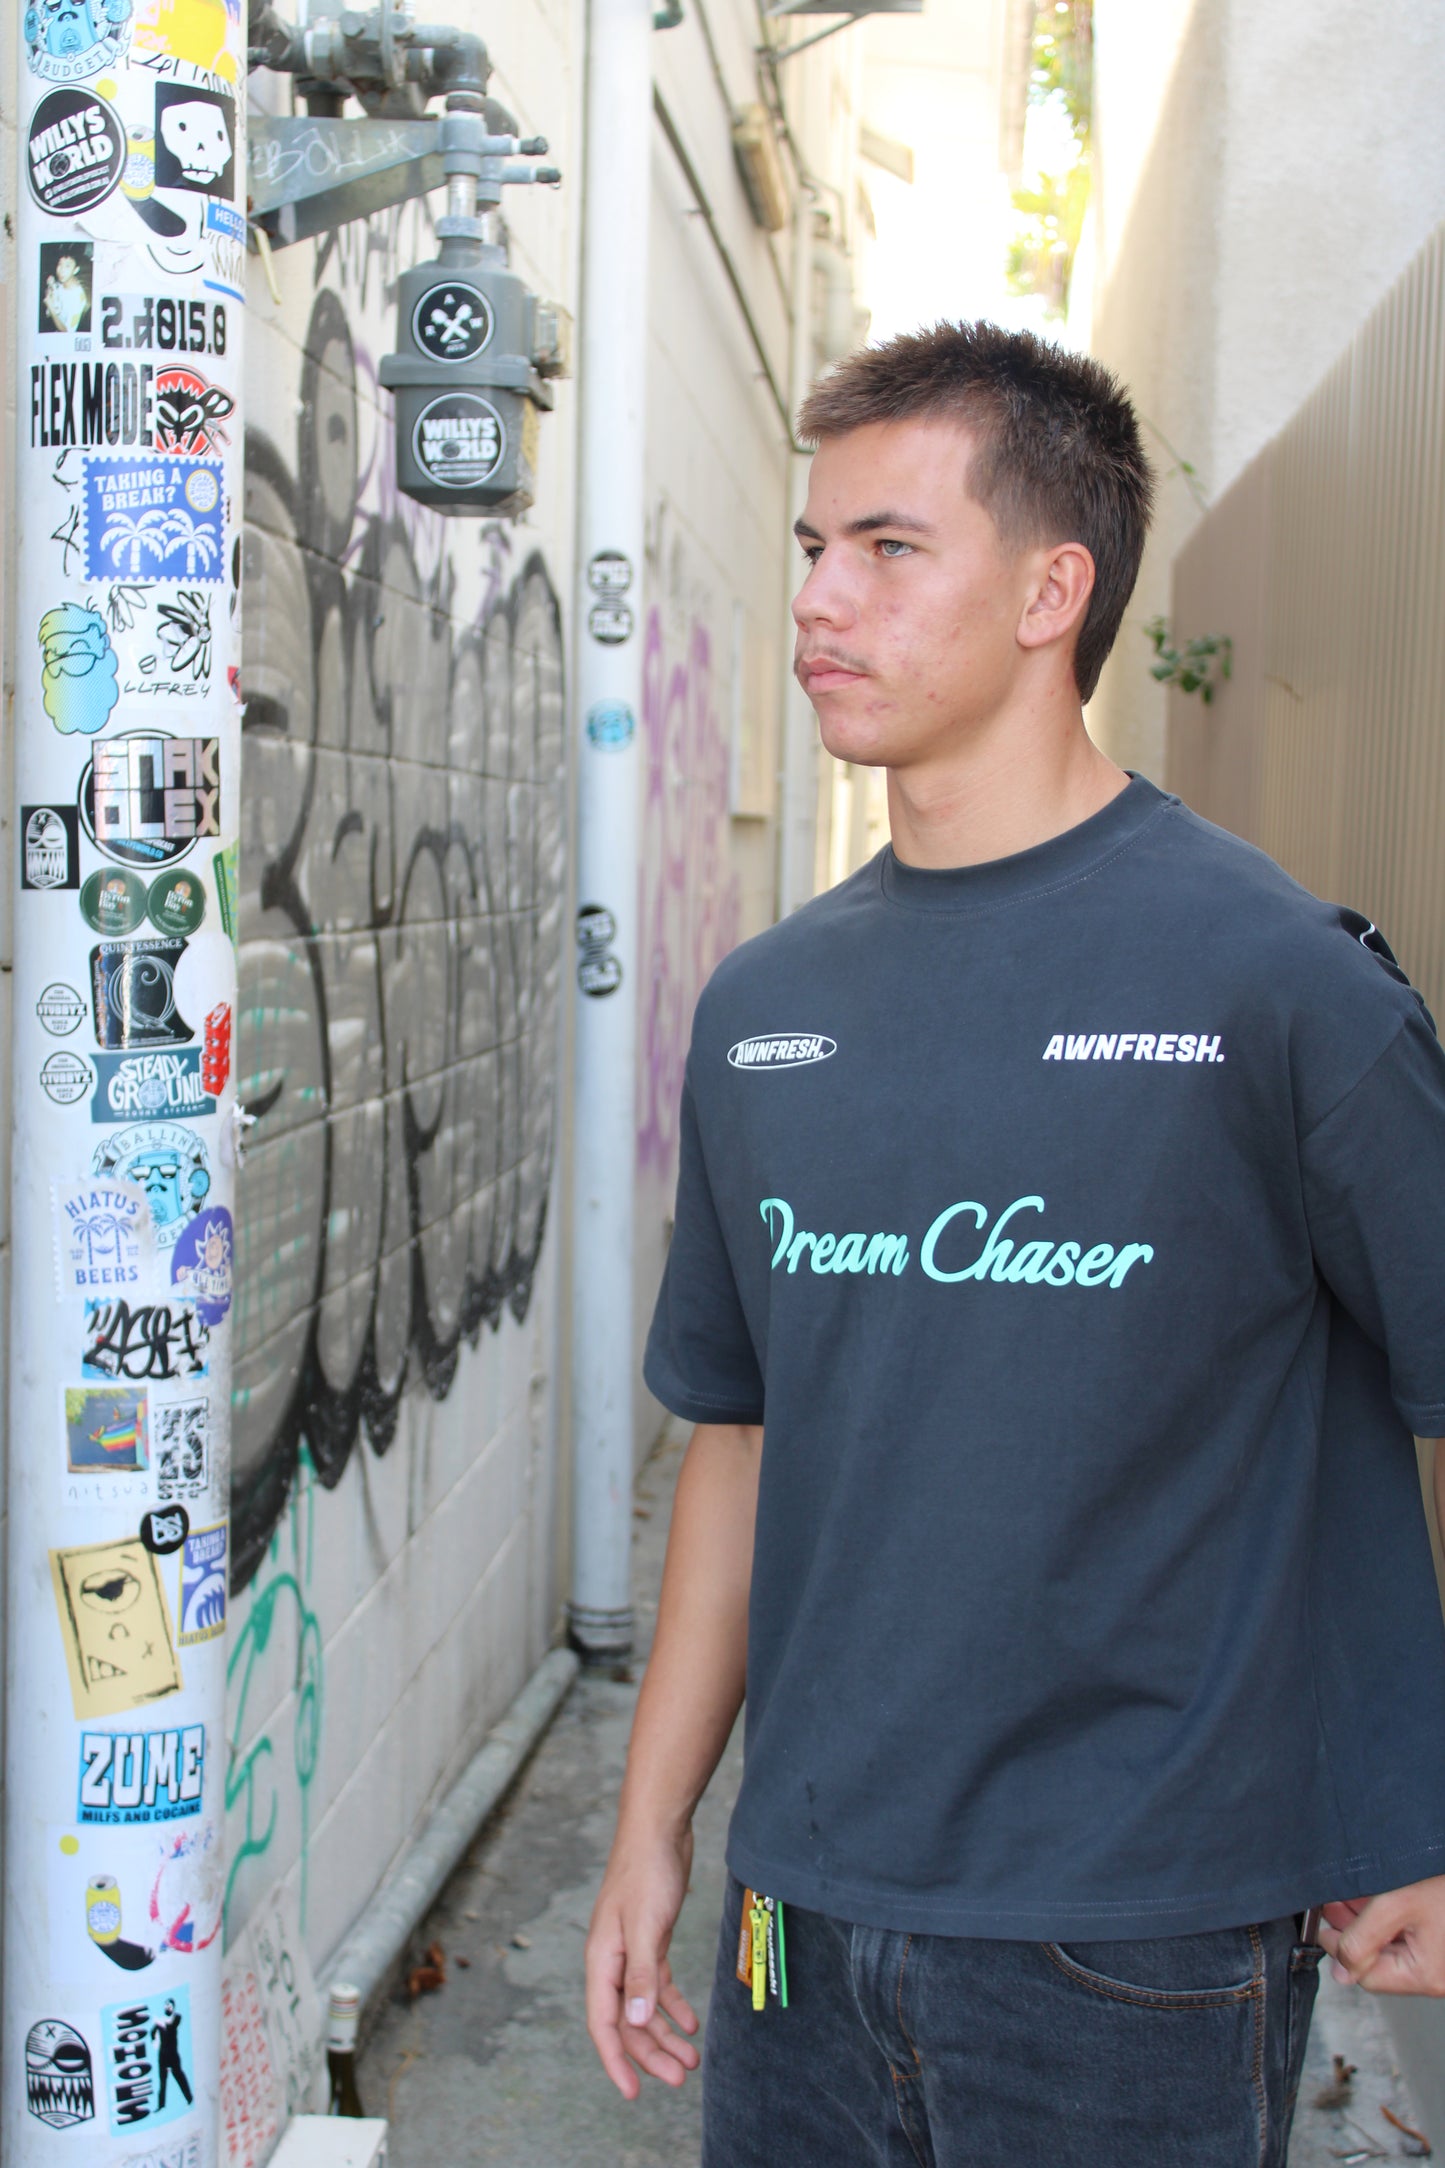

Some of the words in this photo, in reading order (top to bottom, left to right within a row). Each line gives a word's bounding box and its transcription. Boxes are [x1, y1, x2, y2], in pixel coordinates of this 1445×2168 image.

[42, 53, 107, 78] BUDGET
[29, 104, 106, 163] WILLYS
[32, 134, 114, 191] WORLD
[31, 363, 76, 448] FLEX
[82, 362, 153, 447] MODE
[422, 417, 497, 440] WILLYS
[422, 439, 499, 462] WORLD
[94, 469, 165, 494] TAKING
[170, 467, 182, 485] A
[102, 486, 177, 512] BREAK?
[100, 938, 183, 954] QUINTESSENCE
[735, 1037, 825, 1064] AWNFRESH.
[1042, 1033, 1225, 1063] AWNFRESH.
[119, 1054, 188, 1083] STEADY
[121, 1128, 189, 1152] BALLIN
[64, 1190, 140, 1219] HIATUS
[759, 1197, 910, 1276] Dream
[920, 1195, 1155, 1289] Chaser
[75, 1265, 139, 1286] BEERS
[81, 1725, 204, 1808] ZUME
[82, 1810, 120, 1823] MILFS
[124, 1810, 150, 1822] AND
[154, 1803, 201, 1820] COCAINE
